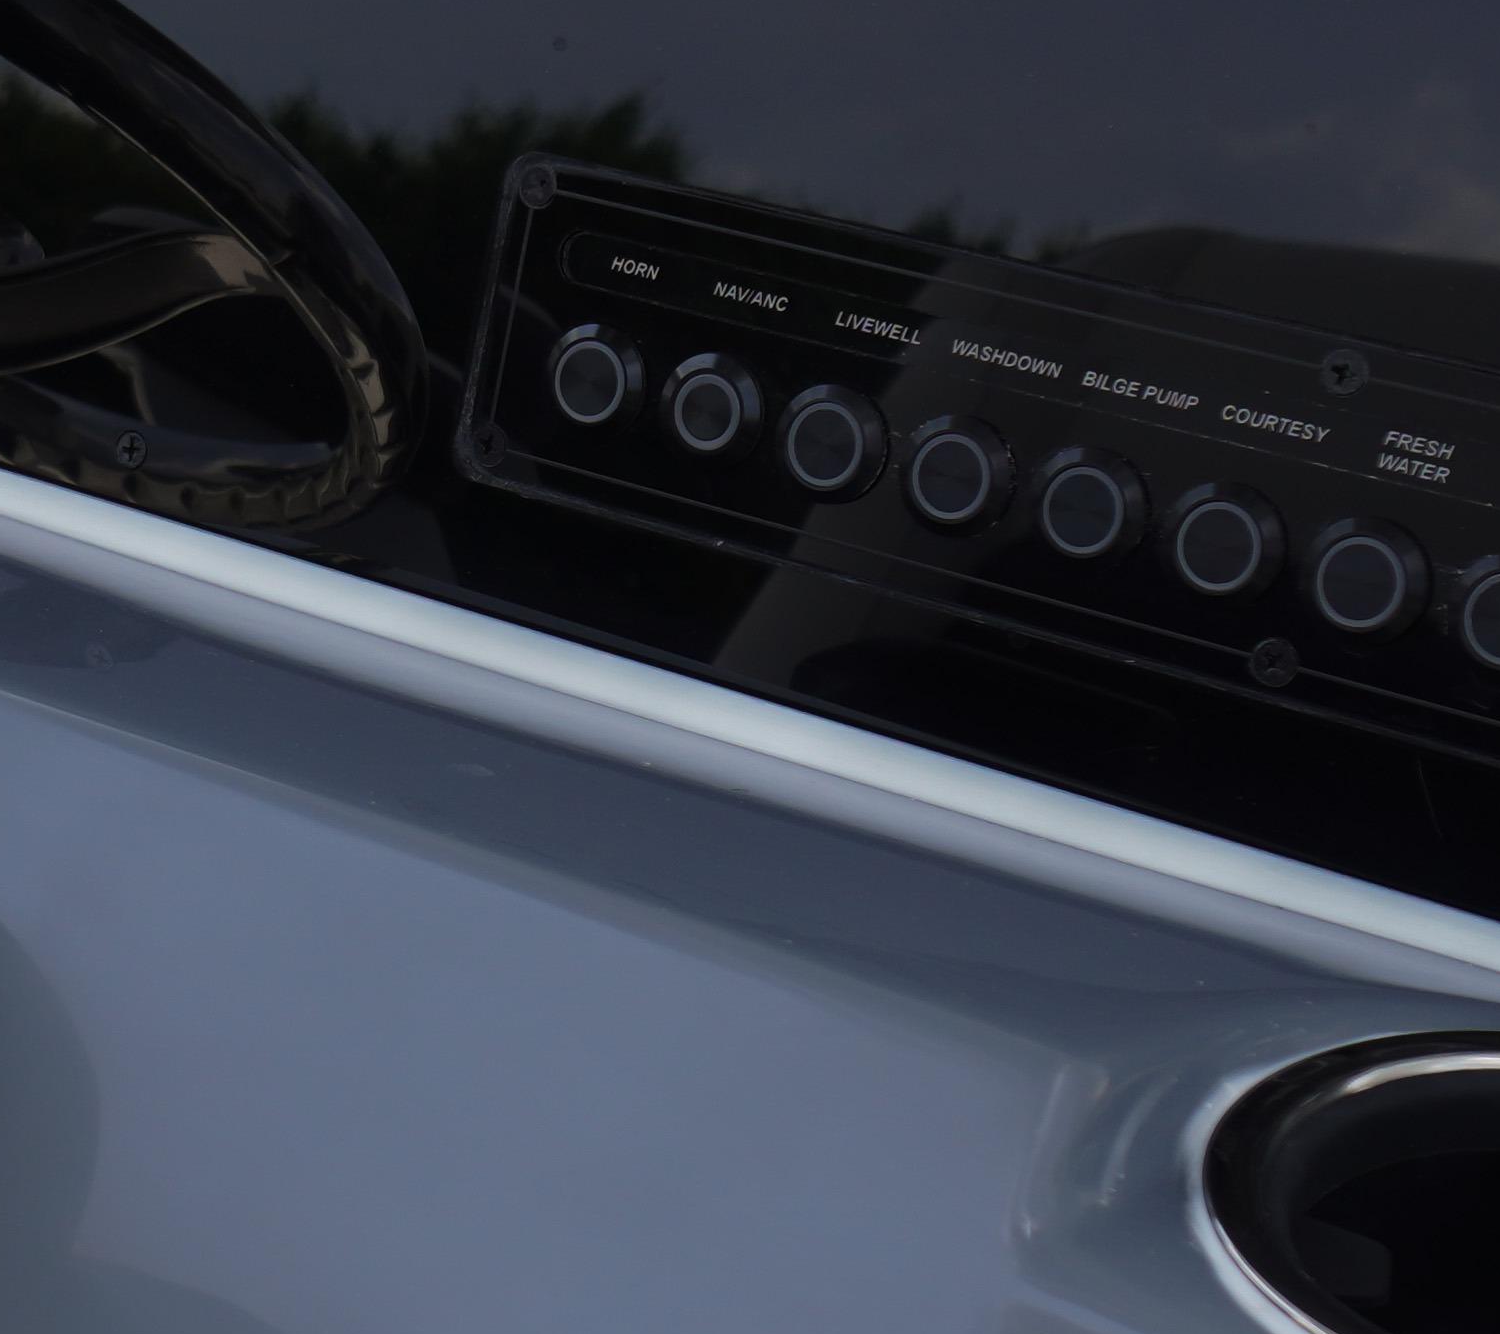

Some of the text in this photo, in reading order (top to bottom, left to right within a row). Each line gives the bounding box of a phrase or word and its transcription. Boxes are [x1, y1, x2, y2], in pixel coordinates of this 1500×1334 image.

[611, 256, 660, 281] HORN
[713, 281, 789, 312] NAV/ANC
[834, 310, 921, 345] LIVEWELL
[951, 339, 1063, 378] WASHDOWN
[1081, 371, 1199, 411] BILGE PUMP
[1222, 405, 1331, 442] COURTESY
[1384, 431, 1455, 460] FRESH
[1378, 453, 1450, 483] WATER
